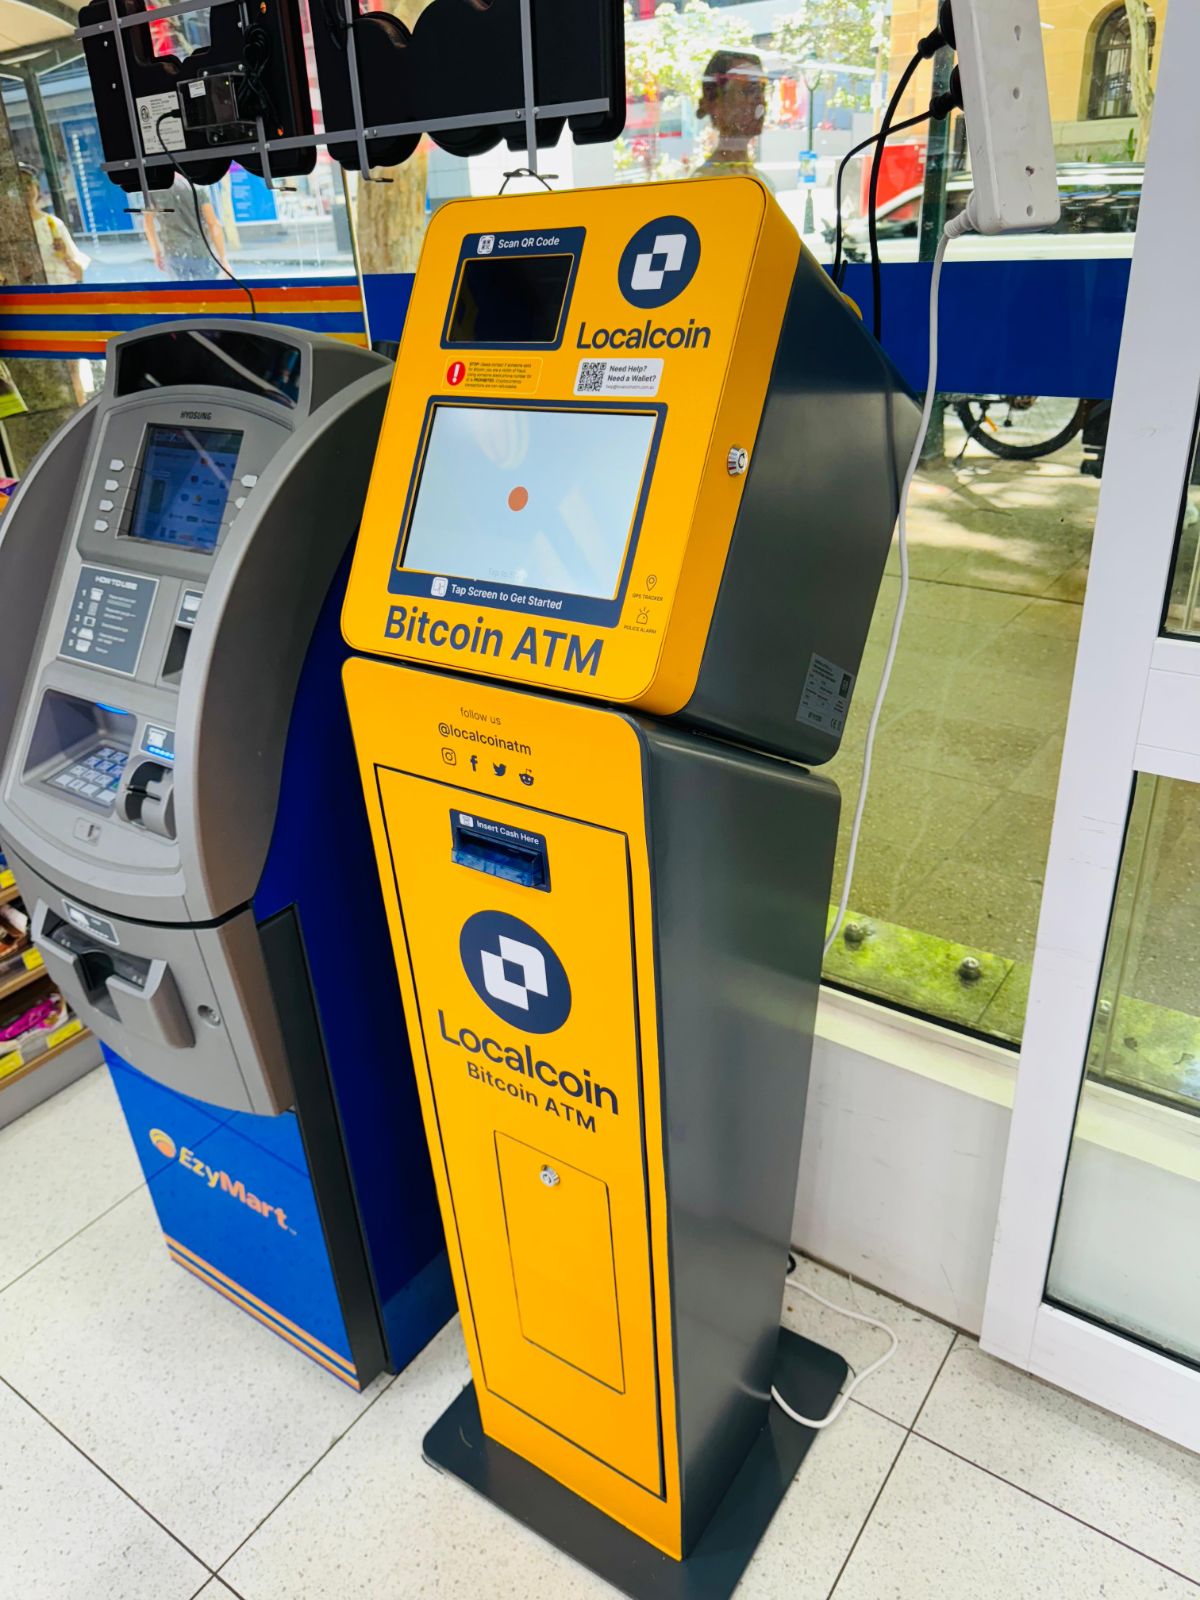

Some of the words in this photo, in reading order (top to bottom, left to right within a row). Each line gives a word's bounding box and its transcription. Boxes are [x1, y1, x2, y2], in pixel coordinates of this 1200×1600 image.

[498, 239, 519, 249] Scan
[521, 237, 534, 248] QR
[536, 236, 560, 246] Code
[576, 319, 711, 349] Localcoin
[628, 365, 647, 373] Help?
[180, 411, 212, 420] HYOSUNG
[451, 583, 466, 597] Tap
[467, 586, 498, 600] Screen
[500, 591, 508, 602] to
[510, 593, 526, 604] Get
[528, 595, 563, 610] Started
[384, 605, 504, 657] Bitcoin
[510, 626, 604, 677] ATM
[624, 624, 640, 632] POLICE
[460, 706, 488, 722] follow
[490, 716, 502, 726] us
[438, 722, 532, 756] @localcoinatm
[476, 820, 498, 833] Insert
[500, 826, 519, 839] Cash
[520, 832, 540, 845] Here
[438, 1008, 619, 1116] Localcoin
[466, 1060, 539, 1107] Bitcoin
[545, 1097, 596, 1133] ATM
[178, 1146, 288, 1230] EzyMart
